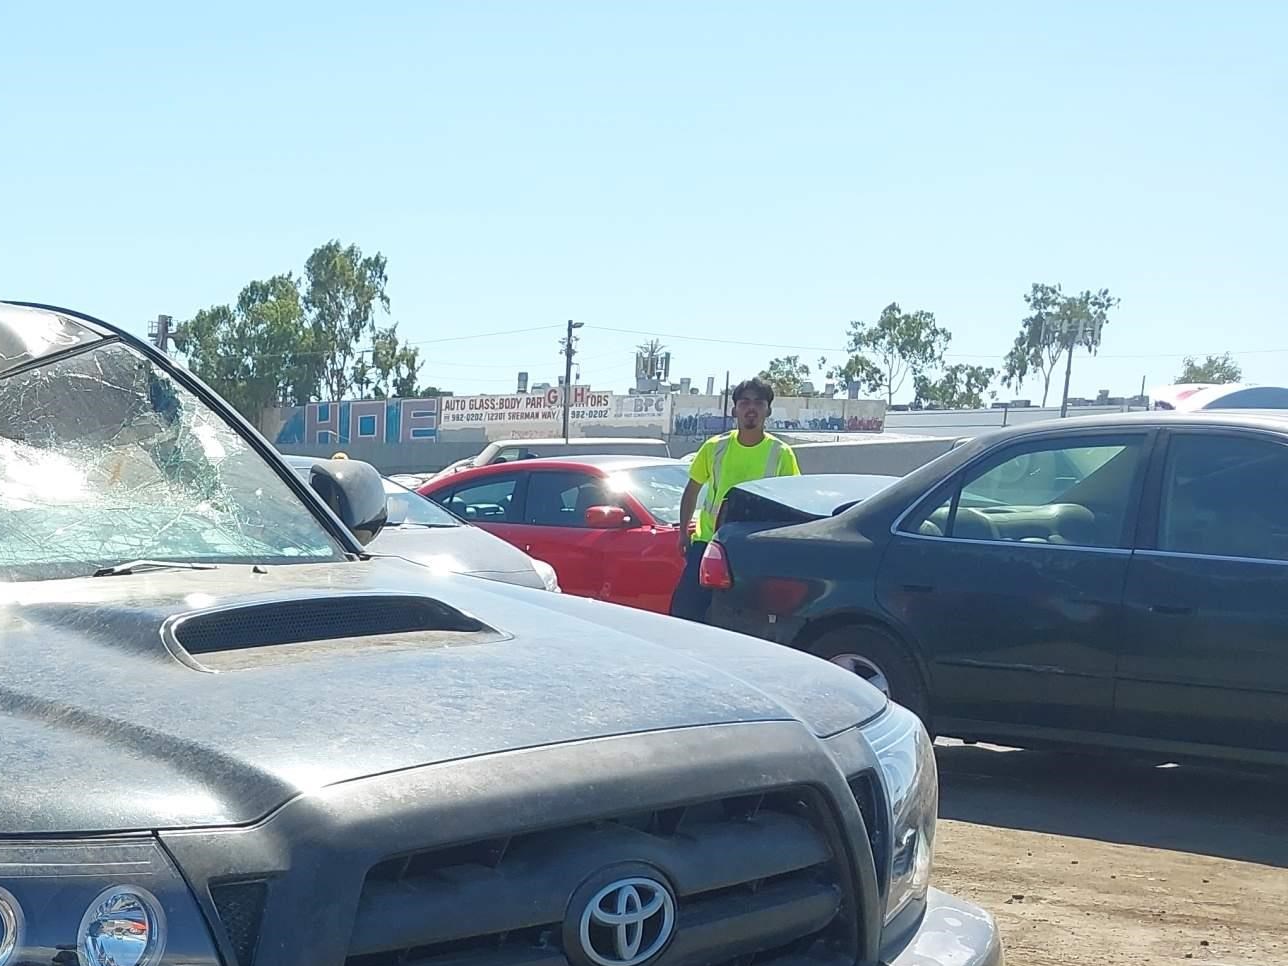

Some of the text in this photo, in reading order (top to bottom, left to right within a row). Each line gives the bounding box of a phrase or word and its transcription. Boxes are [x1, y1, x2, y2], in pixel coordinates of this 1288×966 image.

[444, 400, 466, 411] AUTO
[633, 398, 665, 413] BPC
[508, 411, 540, 420] SHERMAN
